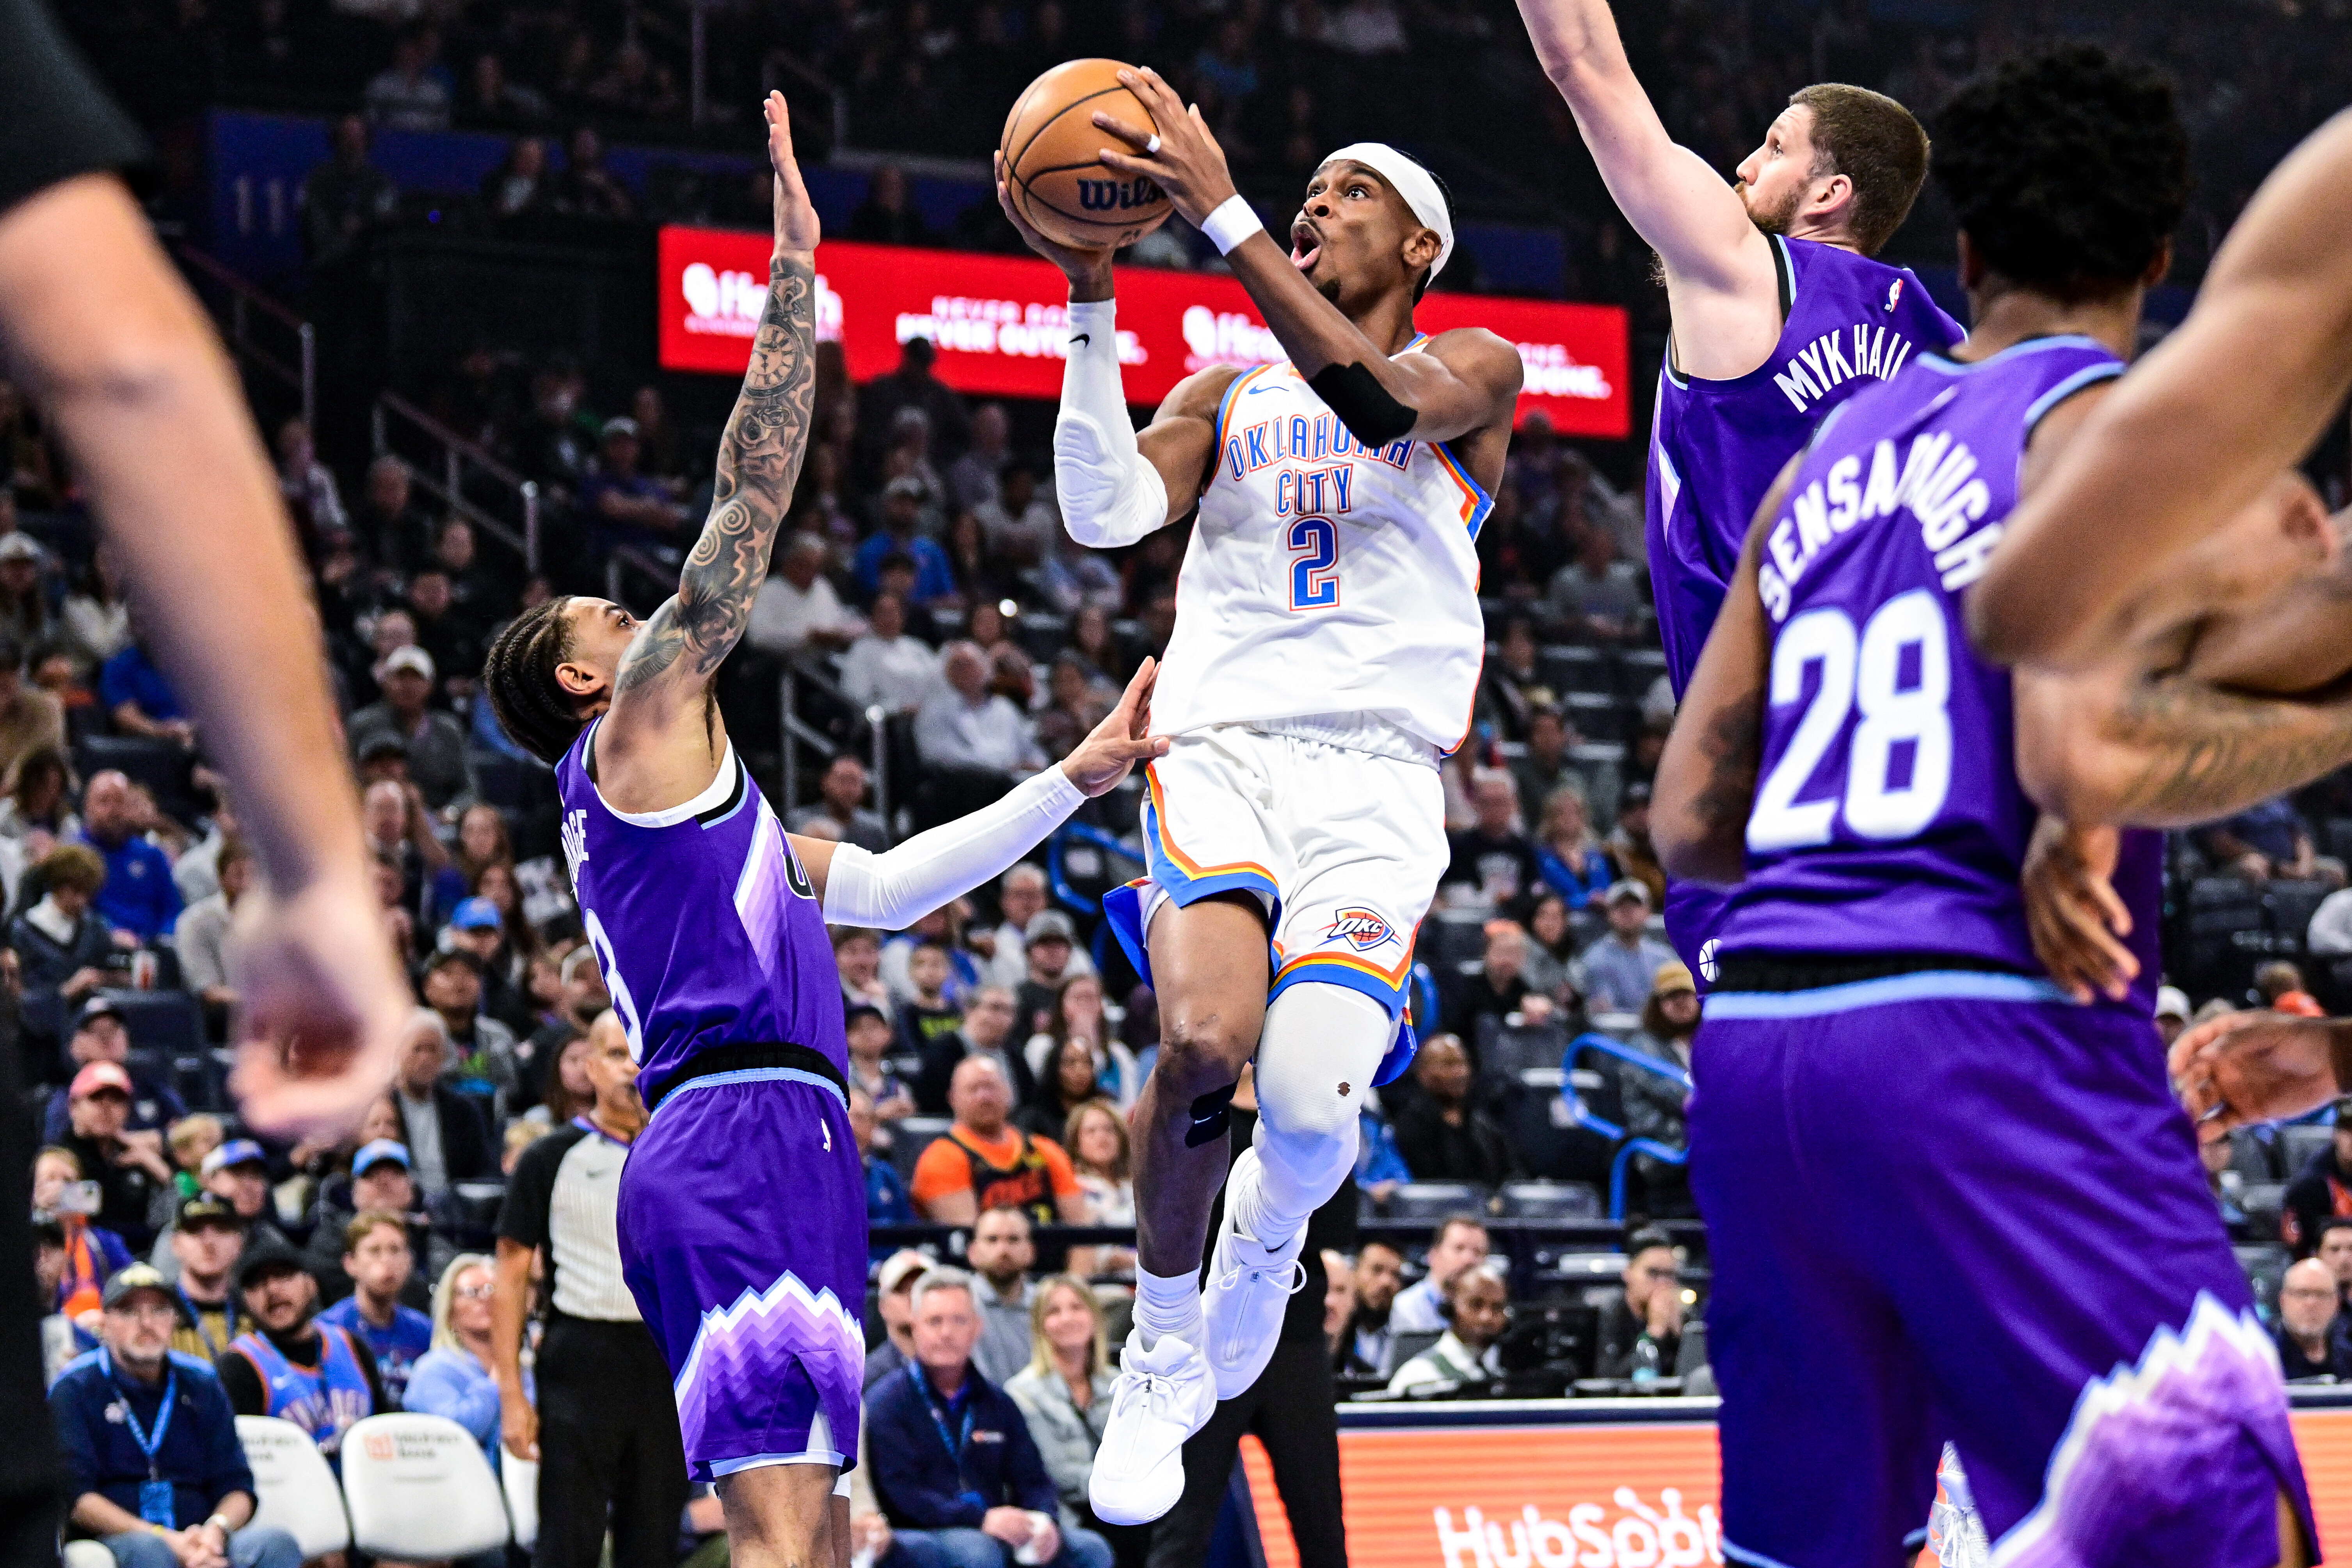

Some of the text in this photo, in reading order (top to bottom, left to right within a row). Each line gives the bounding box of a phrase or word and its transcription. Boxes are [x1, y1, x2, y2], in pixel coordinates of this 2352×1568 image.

[1076, 176, 1160, 211] Wils
[1773, 324, 1911, 413] MYKHAIL
[1275, 463, 1353, 517] CITY
[1288, 515, 1340, 611] 2
[1745, 587, 1953, 853] 28
[1327, 917, 1384, 939] OKC
